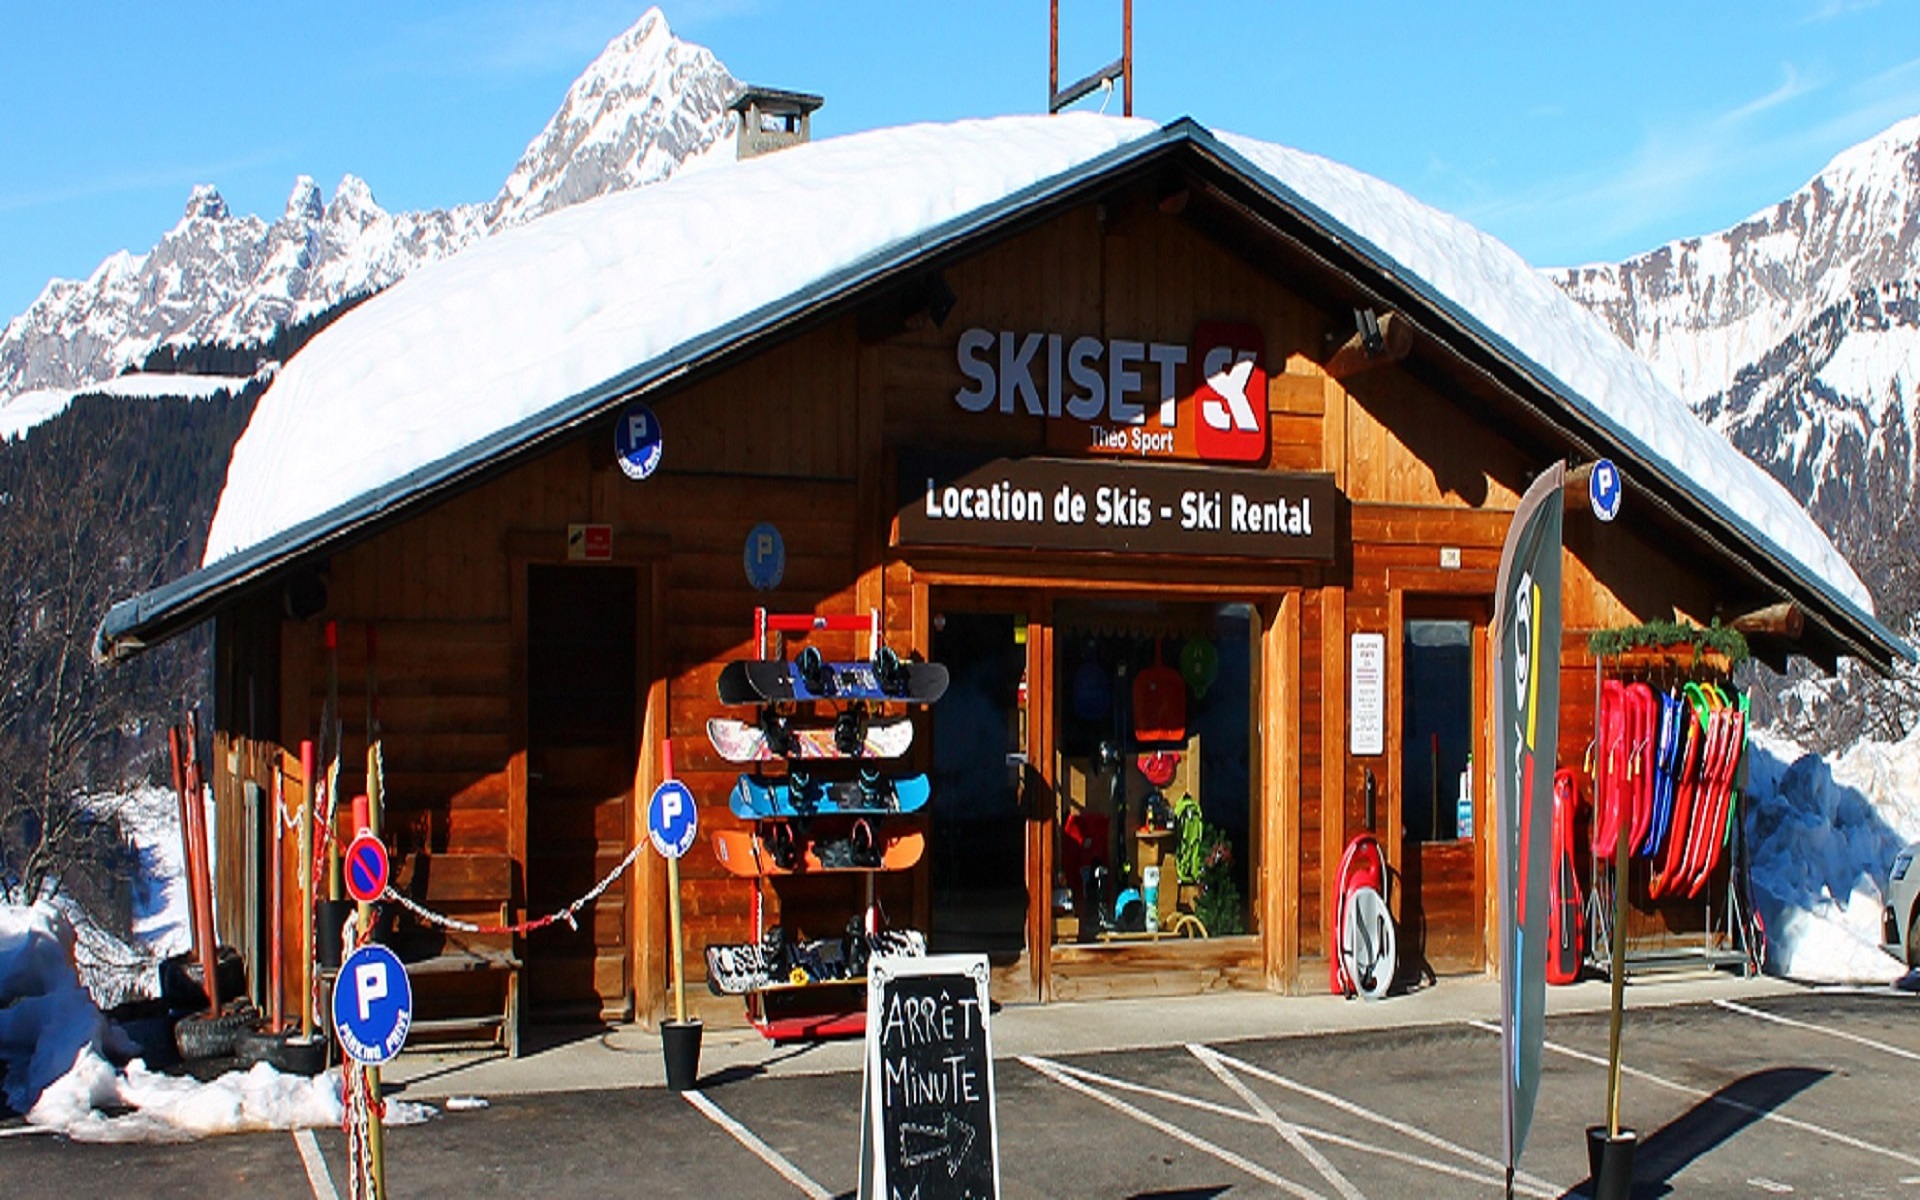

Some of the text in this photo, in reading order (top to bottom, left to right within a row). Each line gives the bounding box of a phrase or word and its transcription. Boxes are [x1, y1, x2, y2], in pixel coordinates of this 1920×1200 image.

[955, 328, 1188, 427] SKISET
[629, 414, 647, 449] P
[1090, 425, 1174, 456] Théo Sport
[1598, 467, 1613, 496] P
[926, 477, 1044, 521] Location
[1054, 484, 1086, 523] de
[1095, 486, 1151, 526] Skis
[1181, 491, 1221, 529] Ski
[1231, 493, 1312, 535] Rental
[757, 534, 772, 564] P
[661, 791, 682, 829] P
[355, 962, 388, 1021] P
[882, 989, 979, 1048] ARRÊT
[339, 1021, 383, 1060] PARKING
